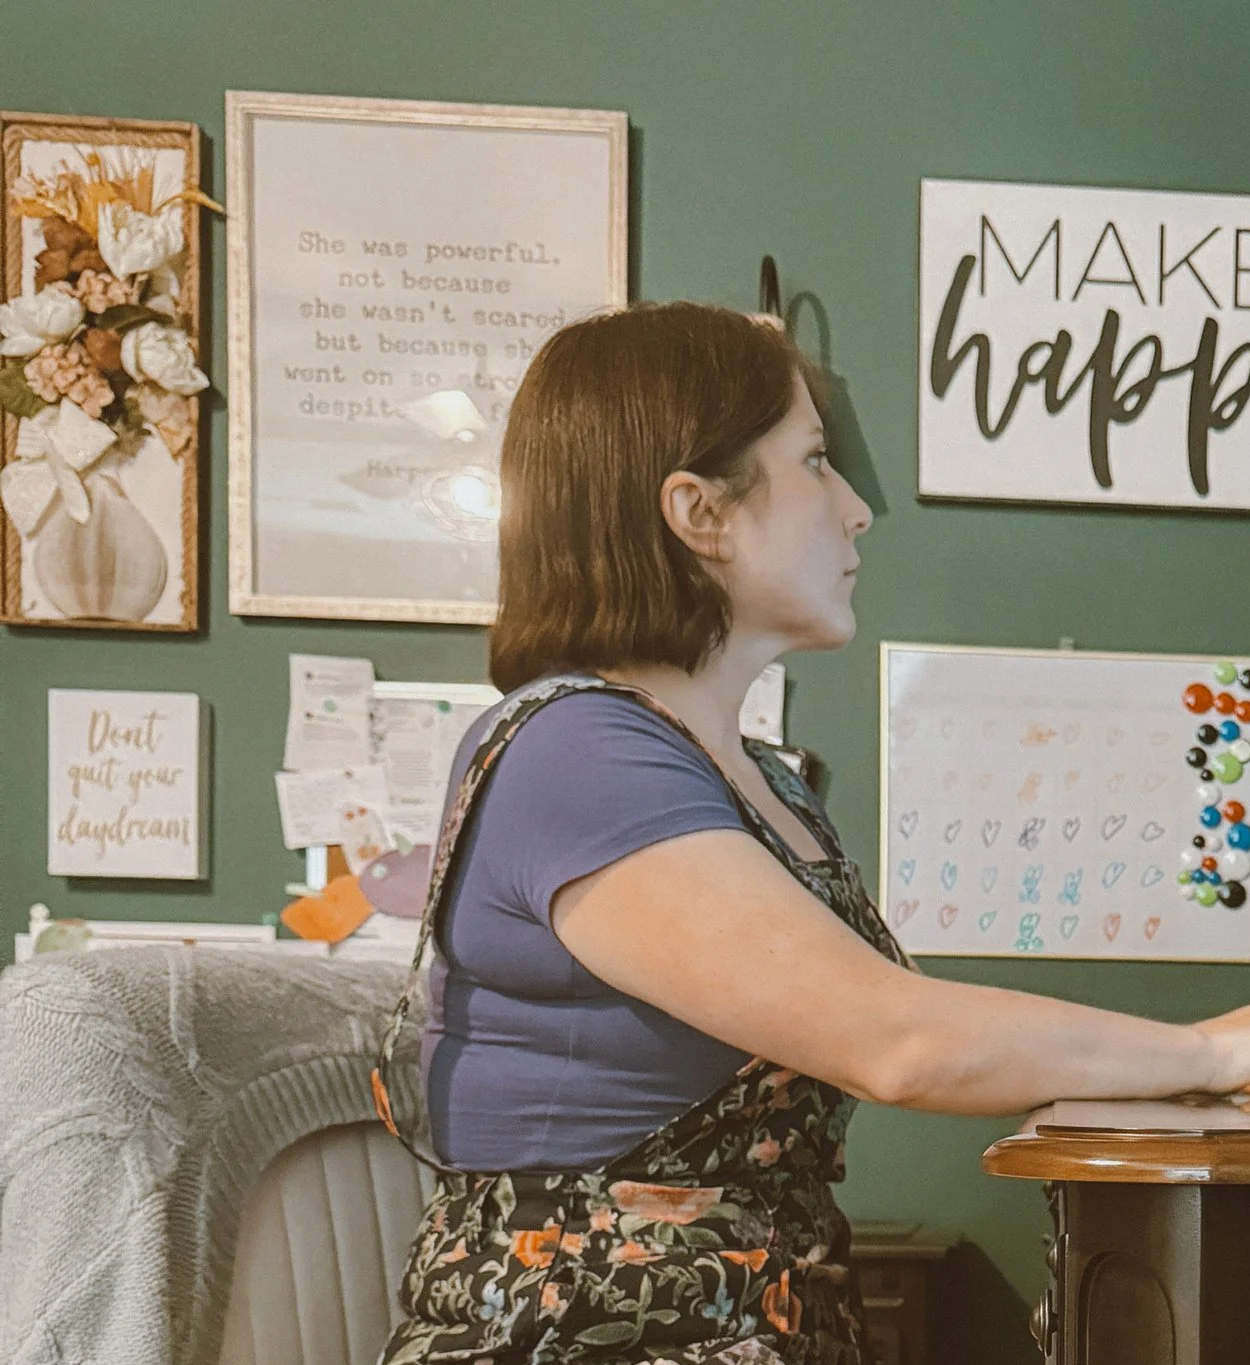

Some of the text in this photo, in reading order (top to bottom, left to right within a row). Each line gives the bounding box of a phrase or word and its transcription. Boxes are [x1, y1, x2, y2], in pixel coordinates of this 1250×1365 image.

[299, 231, 346, 255] She
[361, 239, 408, 258] was
[338, 268, 511, 294] not because
[299, 297, 566, 330] she wasn't scared
[315, 331, 536, 361] but because sh
[284, 364, 346, 384] went
[361, 367, 394, 386] on
[88, 708, 169, 755] Dont
[68, 757, 185, 805] quit your
[57, 804, 191, 860] daydream
